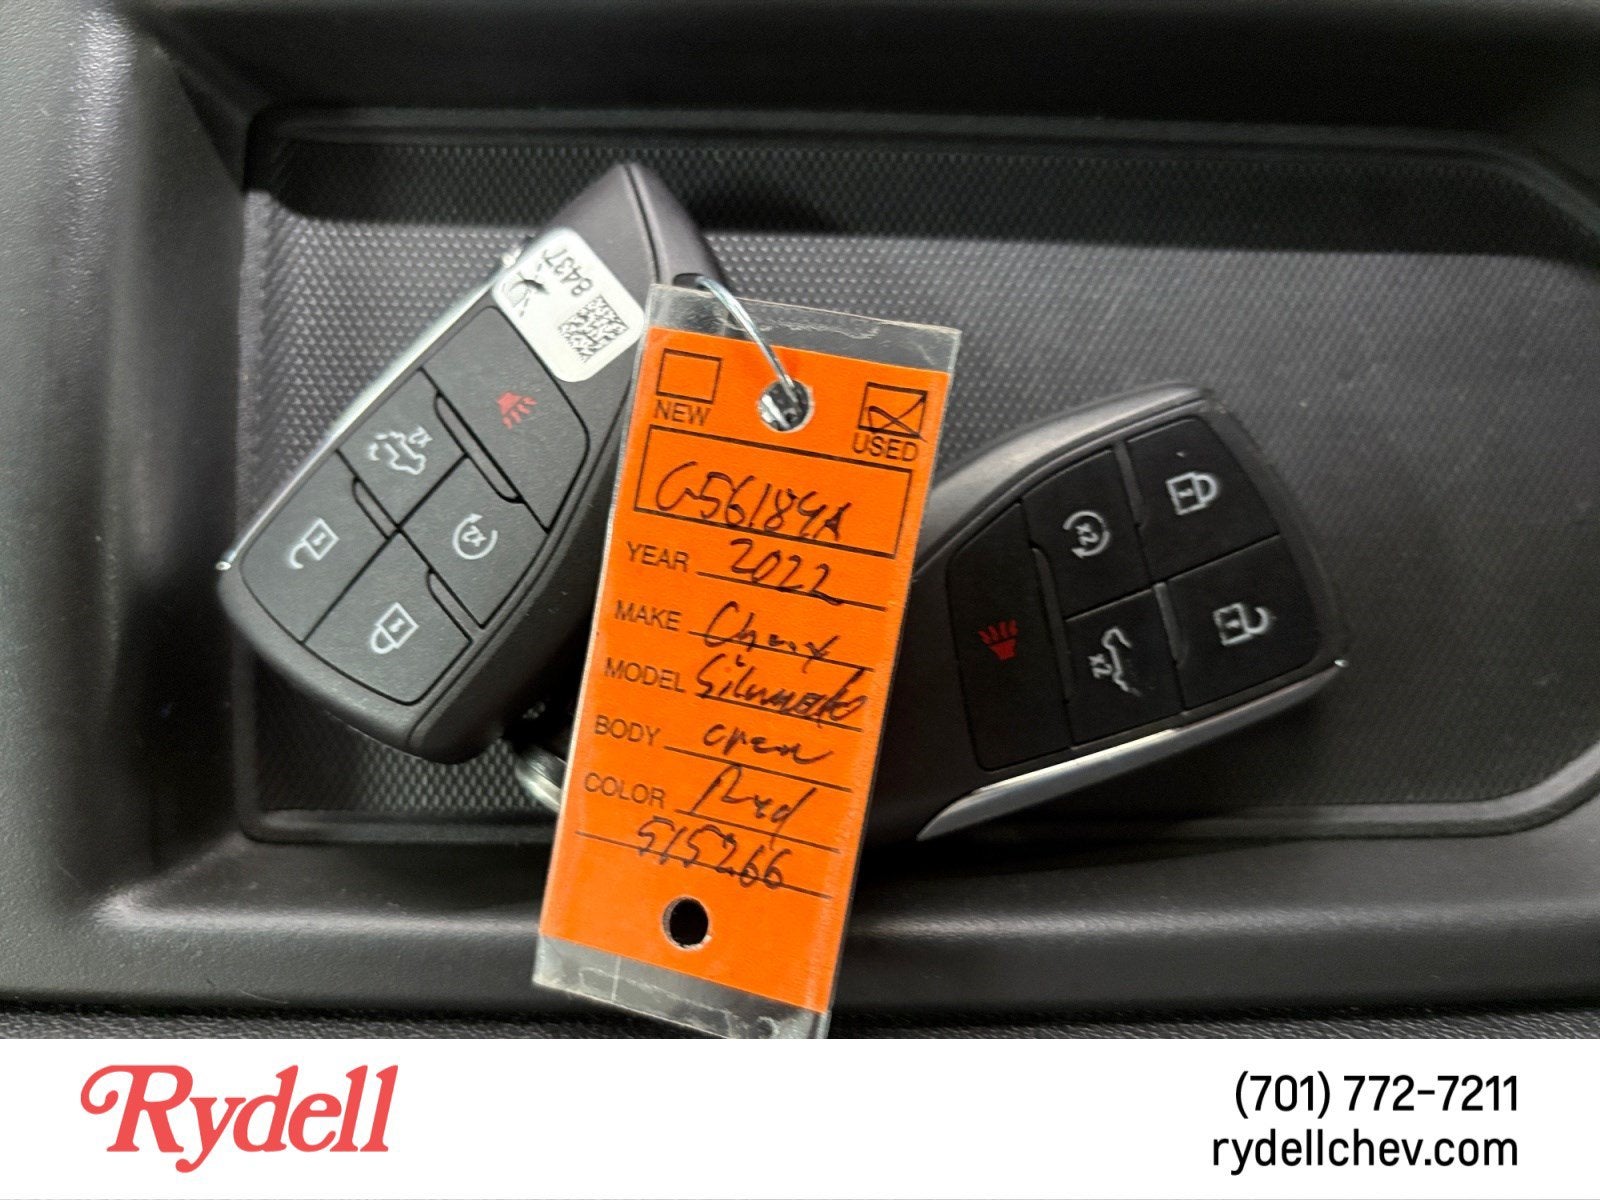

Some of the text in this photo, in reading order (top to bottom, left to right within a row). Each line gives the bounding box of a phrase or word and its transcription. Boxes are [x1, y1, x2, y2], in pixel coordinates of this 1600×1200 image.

[653, 400, 711, 427] NEW
[851, 433, 919, 462] USED
[626, 538, 845, 606] YEAR 2022
[614, 600, 683, 633] MAKE
[603, 657, 686, 694] MODEL
[593, 714, 661, 748] BODY
[584, 771, 666, 808] COLOR
